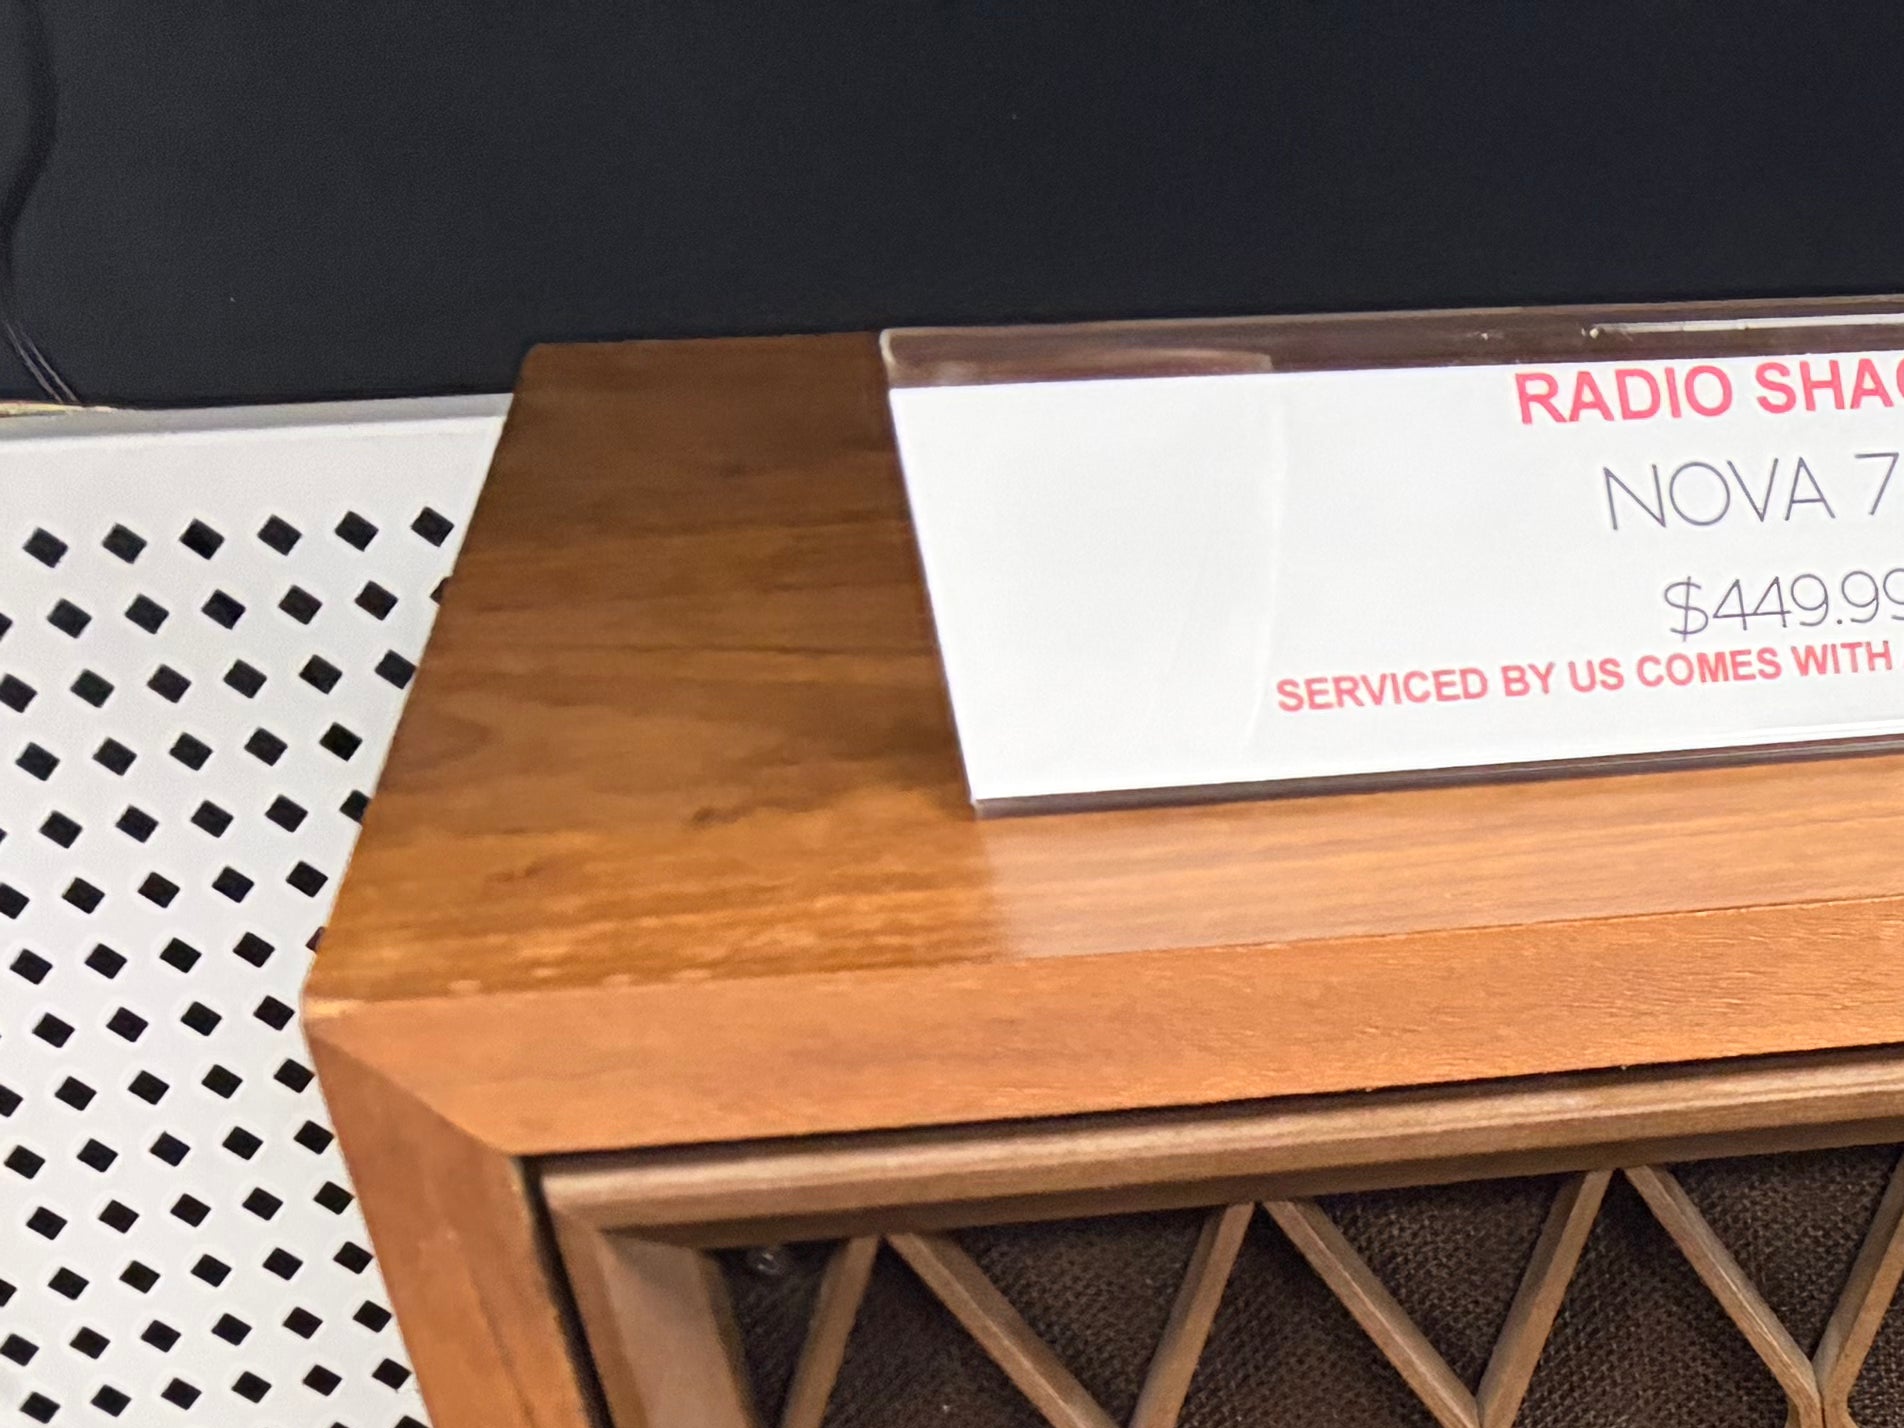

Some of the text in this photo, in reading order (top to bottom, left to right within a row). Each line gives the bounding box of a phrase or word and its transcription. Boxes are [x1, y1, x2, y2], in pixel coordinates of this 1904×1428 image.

[1514, 364, 1734, 428] RADIO
[1601, 455, 1838, 532] NOVA
[1275, 666, 1490, 714] SERVICED
[1499, 660, 1557, 699] BY
[1567, 656, 1626, 695] US
[1635, 645, 1783, 689] COMES
[1789, 639, 1894, 678] WITH
